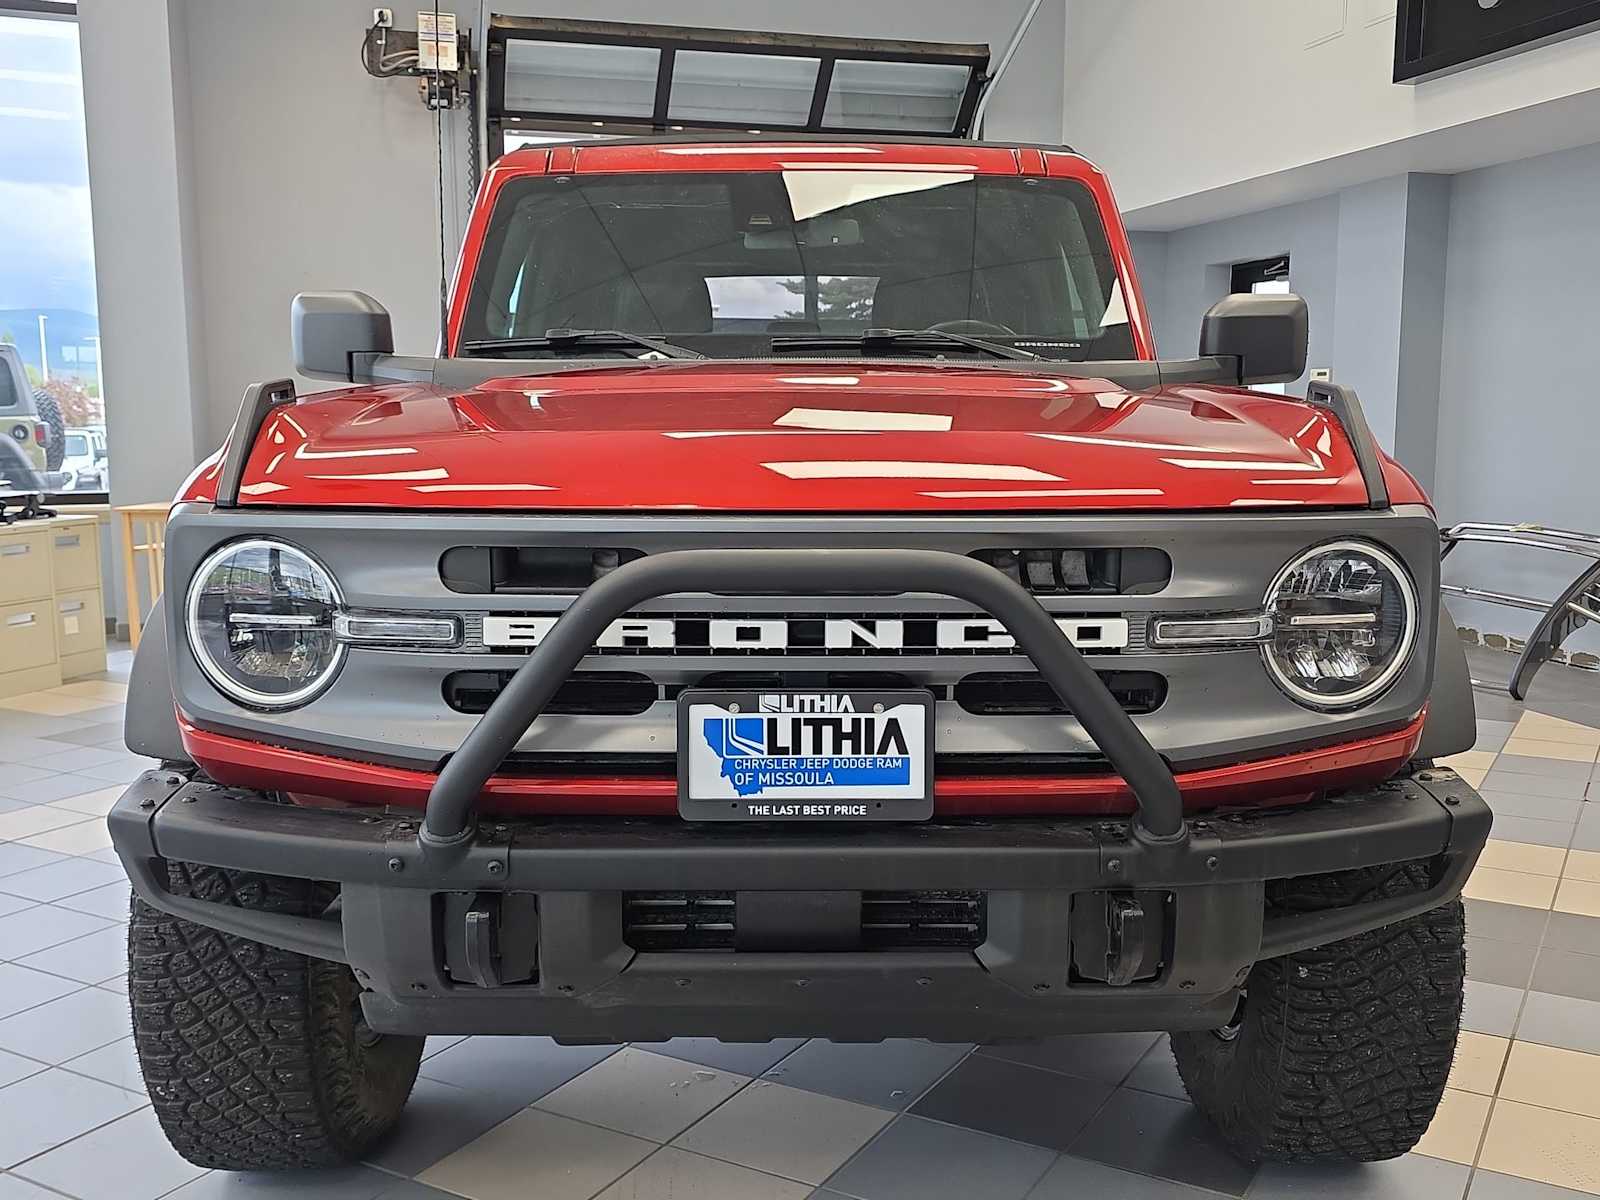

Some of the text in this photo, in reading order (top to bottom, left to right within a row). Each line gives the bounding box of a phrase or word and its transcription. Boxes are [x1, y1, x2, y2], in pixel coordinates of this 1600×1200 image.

[482, 618, 1129, 648] BRONCO
[780, 695, 855, 713] LITHIA
[767, 717, 909, 756] LITHIA
[734, 757, 902, 769] CHRYSLER JEEP DODGE RAM
[734, 771, 834, 785] OF MISSOULA
[748, 805, 867, 816] THE LAST BEST PRICE
